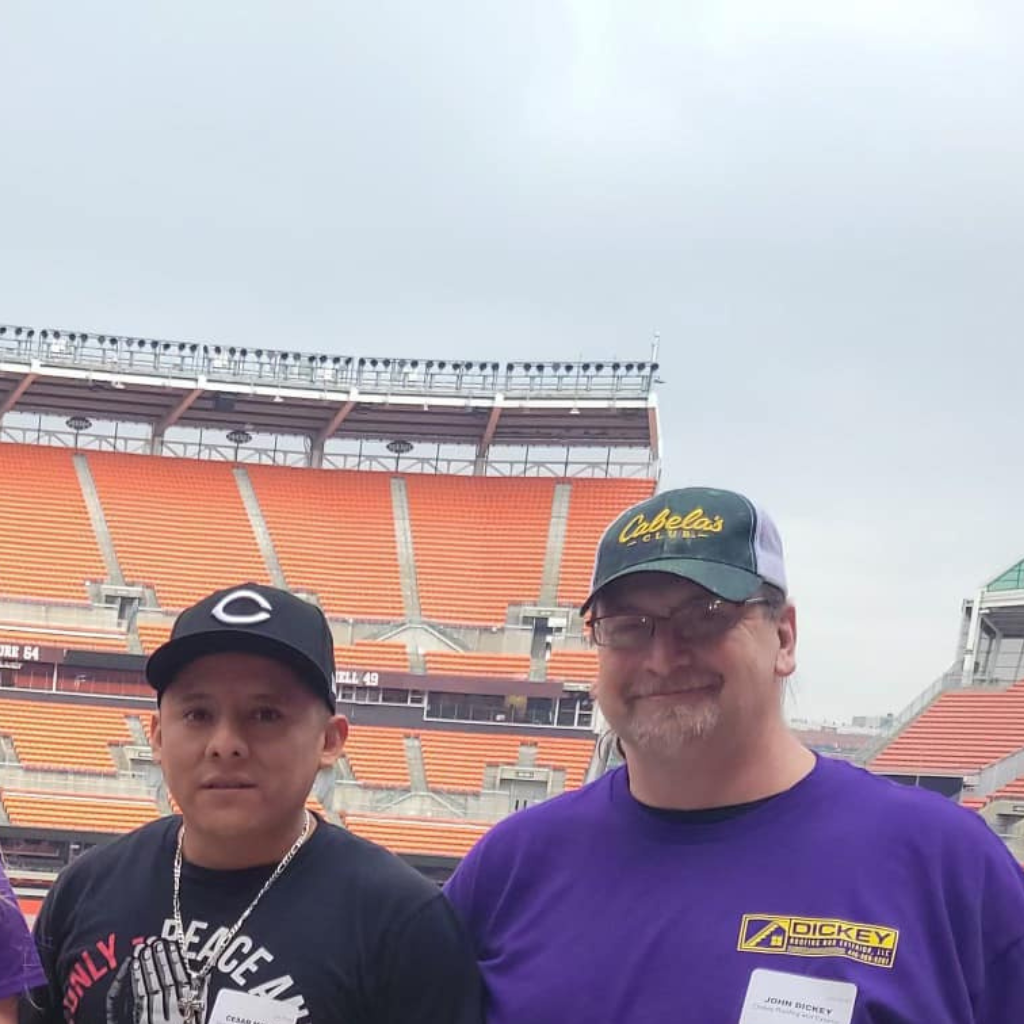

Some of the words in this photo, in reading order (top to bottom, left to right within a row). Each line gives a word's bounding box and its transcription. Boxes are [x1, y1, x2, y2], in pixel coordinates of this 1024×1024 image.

[618, 508, 724, 543] Cabela's
[643, 530, 691, 542] CLUB
[211, 589, 273, 625] C
[23, 645, 39, 661] 64
[362, 671, 379, 686] 49
[792, 922, 891, 944] DICKEY
[160, 918, 274, 986] PEACE
[764, 997, 792, 1009] JOHN
[794, 1002, 833, 1016] DICKEY
